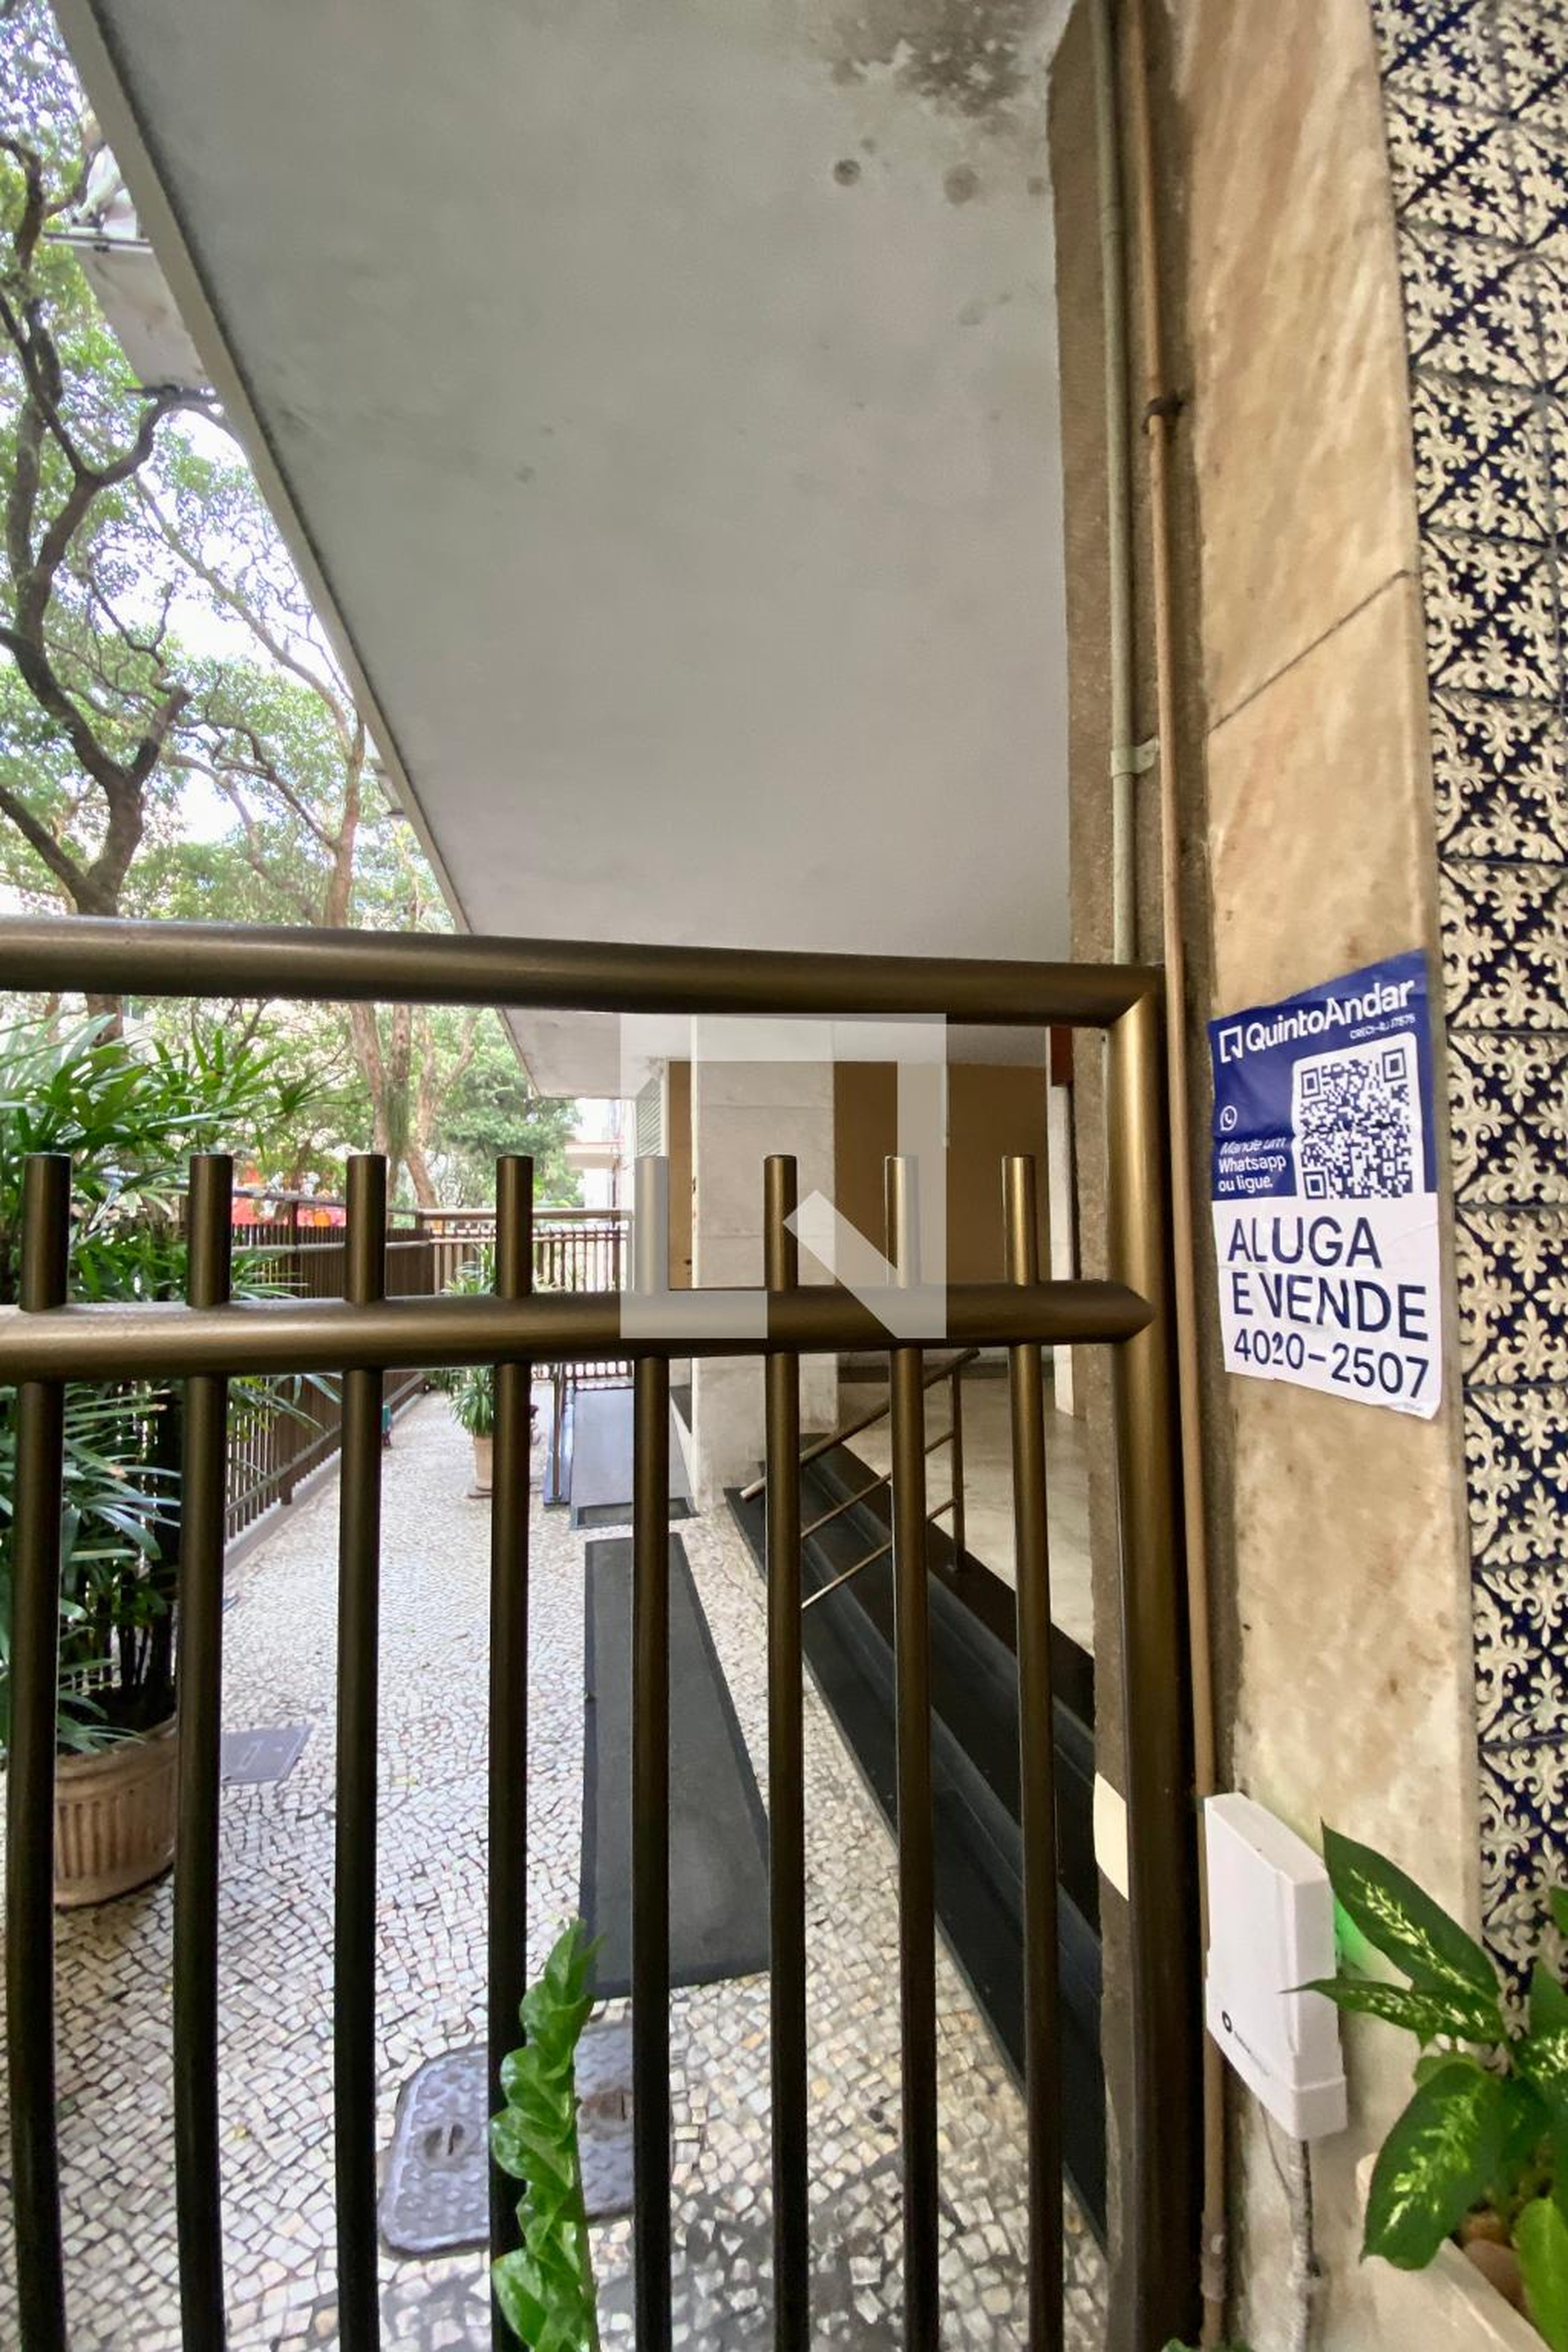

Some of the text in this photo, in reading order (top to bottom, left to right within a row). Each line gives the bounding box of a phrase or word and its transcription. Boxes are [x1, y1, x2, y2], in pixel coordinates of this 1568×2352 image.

[1246, 980, 1414, 1051] QuintoAndar
[1218, 1156, 1287, 1174] Whatsapp
[1218, 1180, 1235, 1192] ou
[1227, 1216, 1382, 1269] ALUGA
[1232, 1272, 1428, 1341] E VENDE
[1234, 1329, 1429, 1399] 4020-2507
